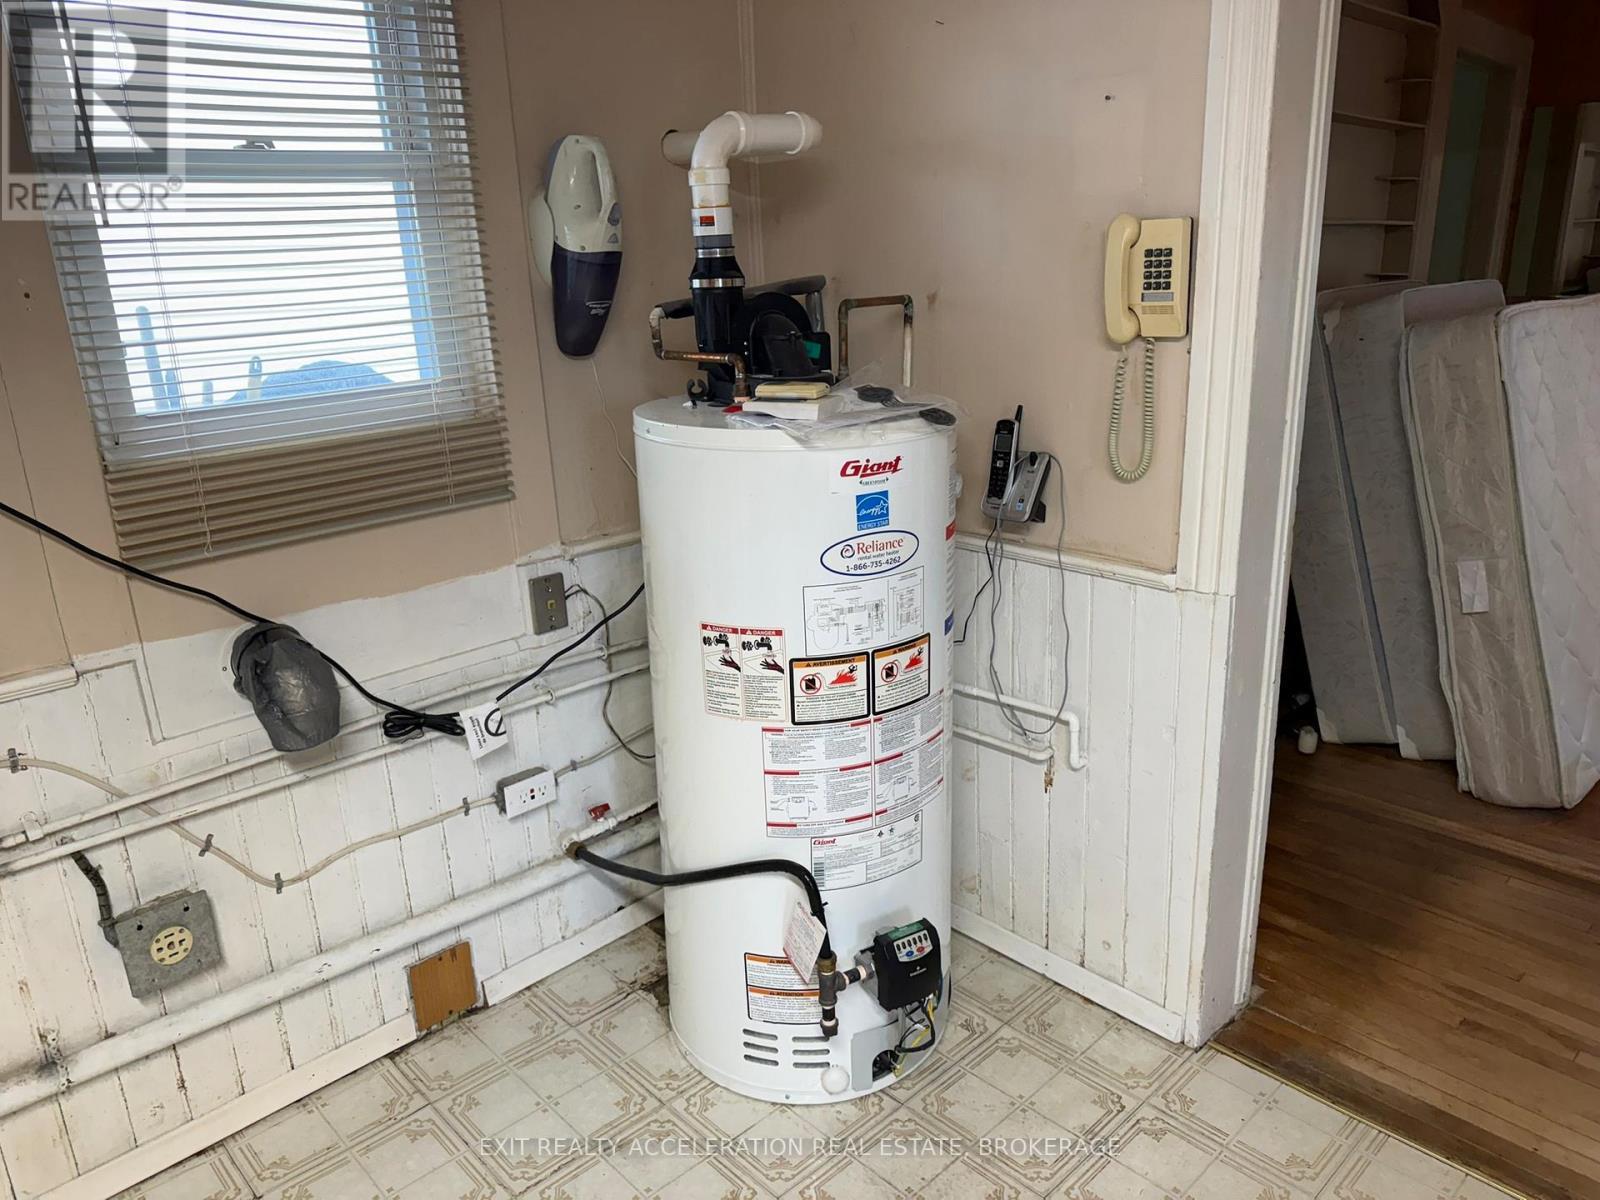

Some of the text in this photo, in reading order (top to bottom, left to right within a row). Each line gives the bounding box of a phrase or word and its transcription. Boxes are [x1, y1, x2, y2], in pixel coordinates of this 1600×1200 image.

[840, 456, 903, 478] Giant
[858, 519, 889, 531] ENERGY STAR
[857, 538, 904, 555] Reliance
[846, 556, 902, 572] 1-866-735-4262
[812, 658, 857, 668] AVERTISSEMENT
[813, 838, 836, 846] Giant
